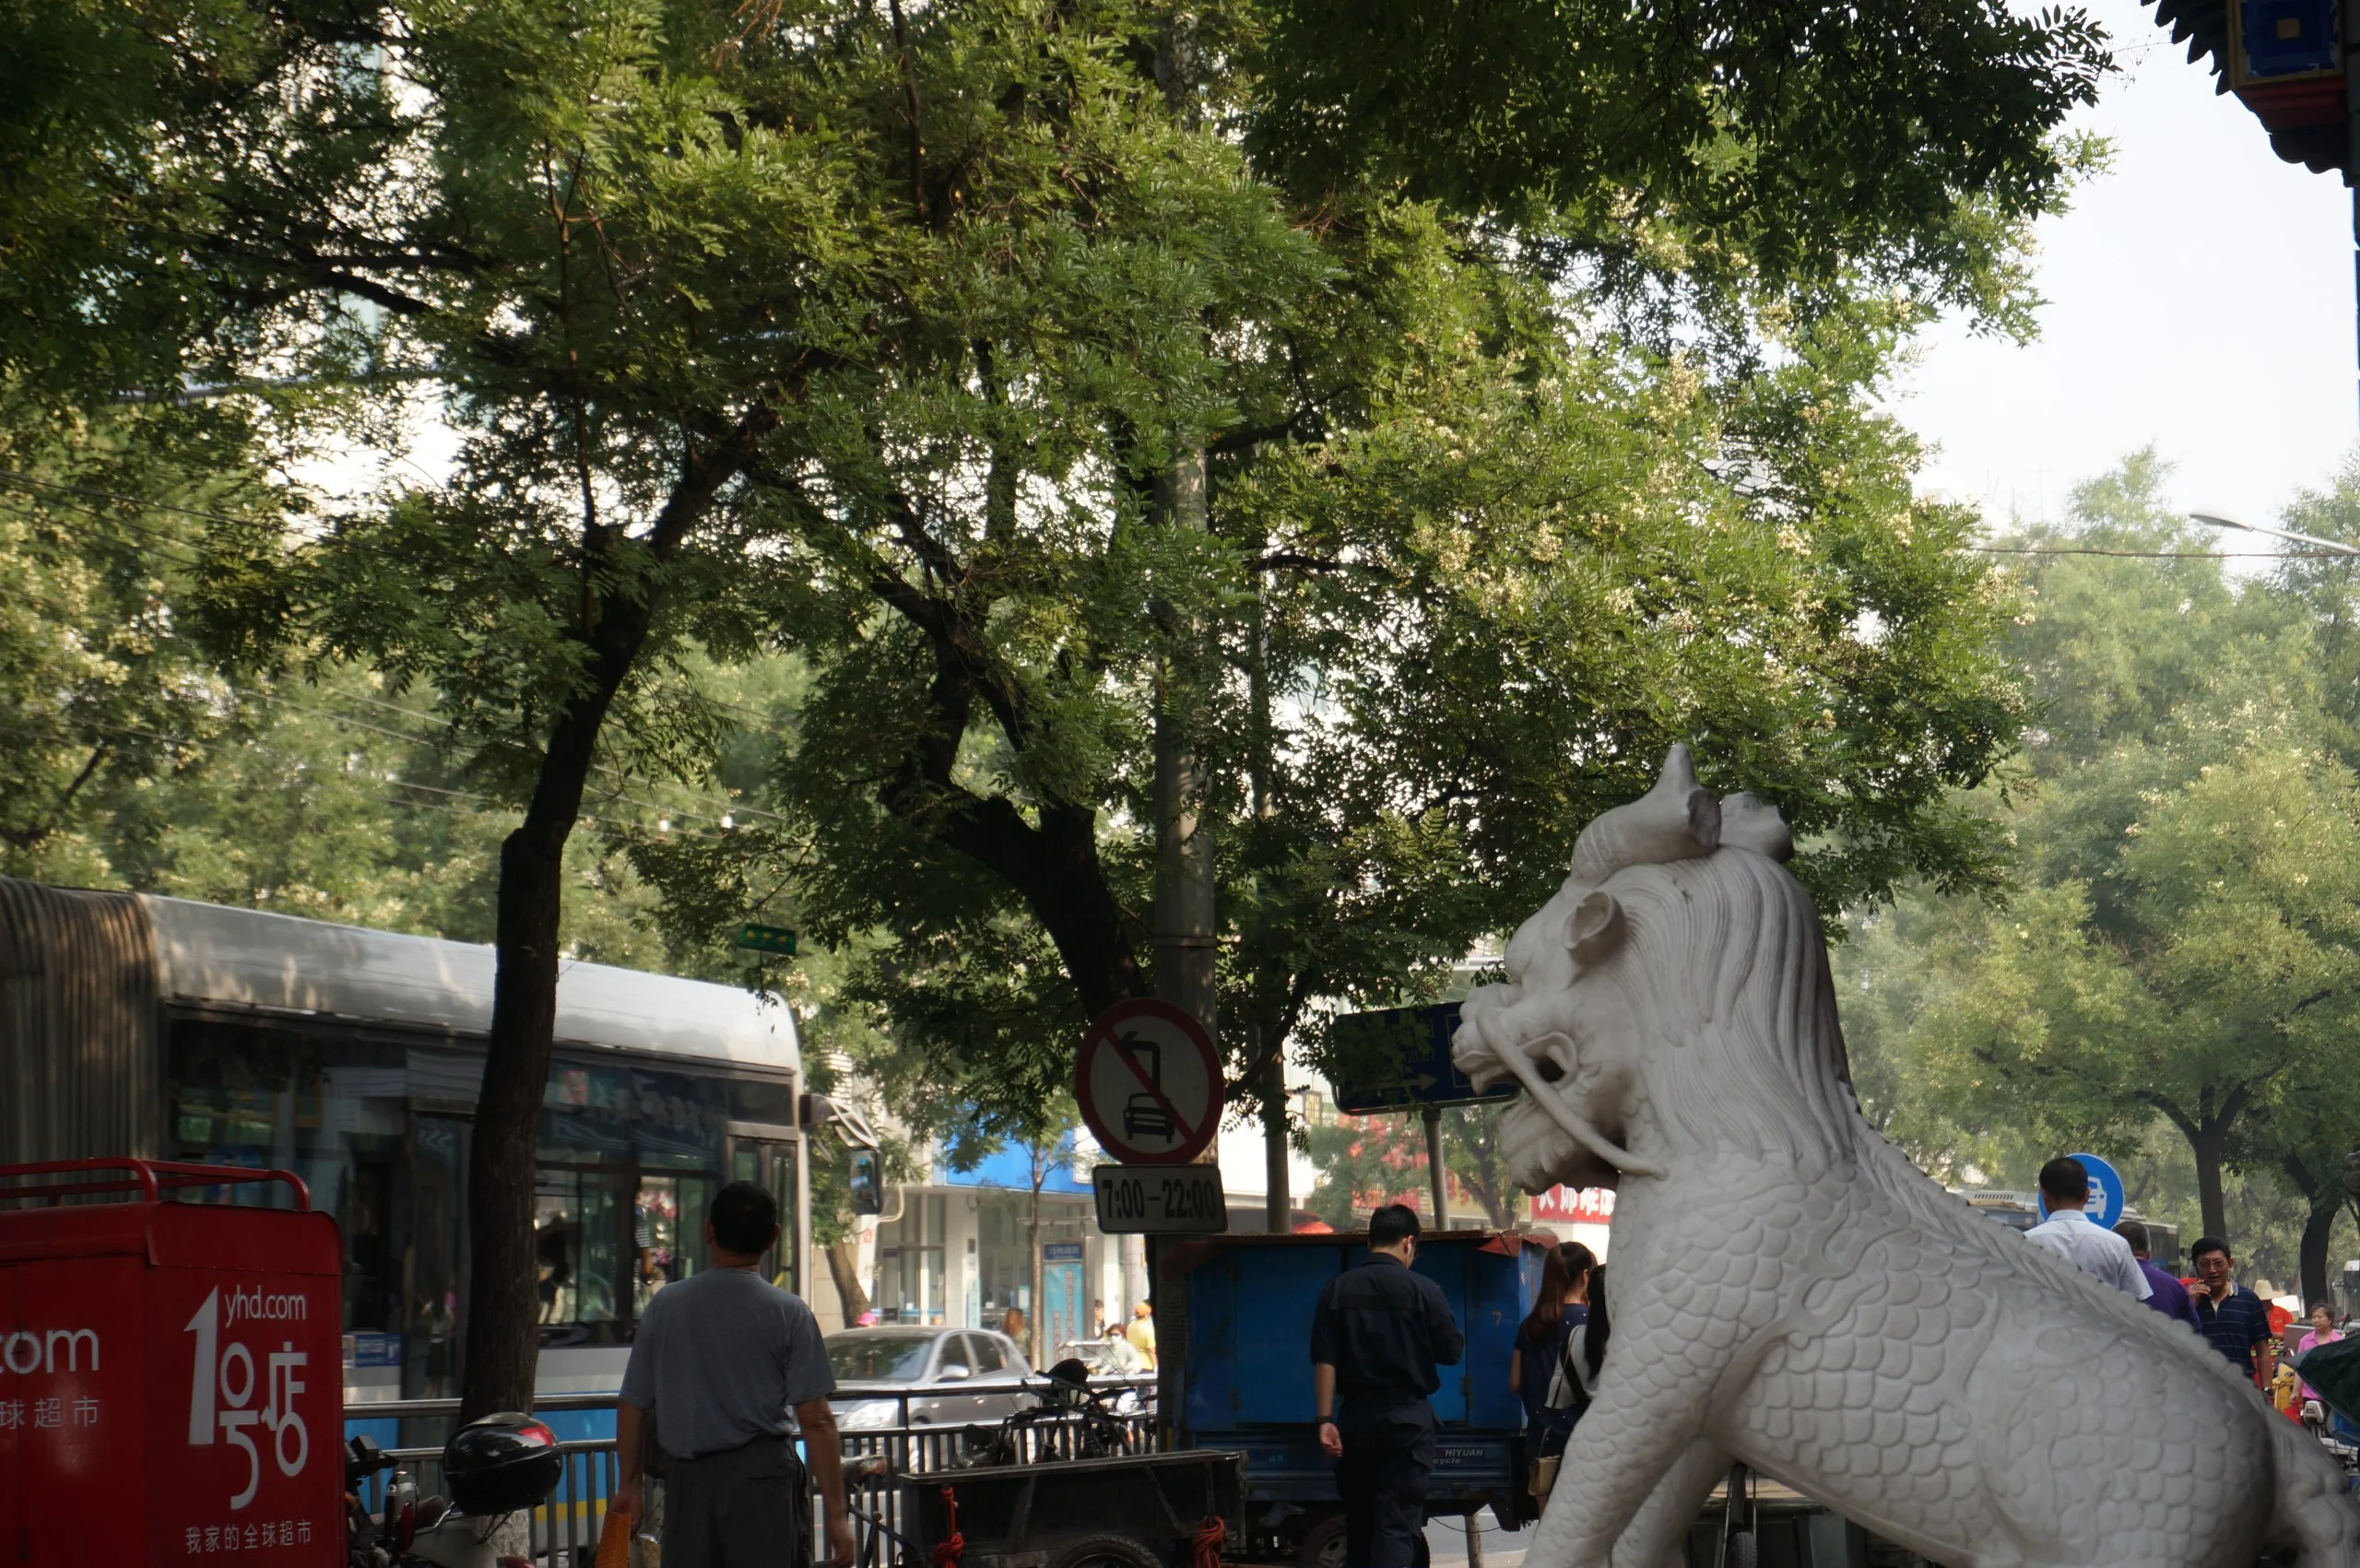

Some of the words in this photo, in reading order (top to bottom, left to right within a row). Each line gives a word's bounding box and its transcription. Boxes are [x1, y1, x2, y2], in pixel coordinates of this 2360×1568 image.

[224, 1284, 307, 1327] yhd.com
[0, 1327, 100, 1374] om
[0, 1396, 100, 1430] 球超市
[184, 1518, 312, 1554] 我家的全球超市
